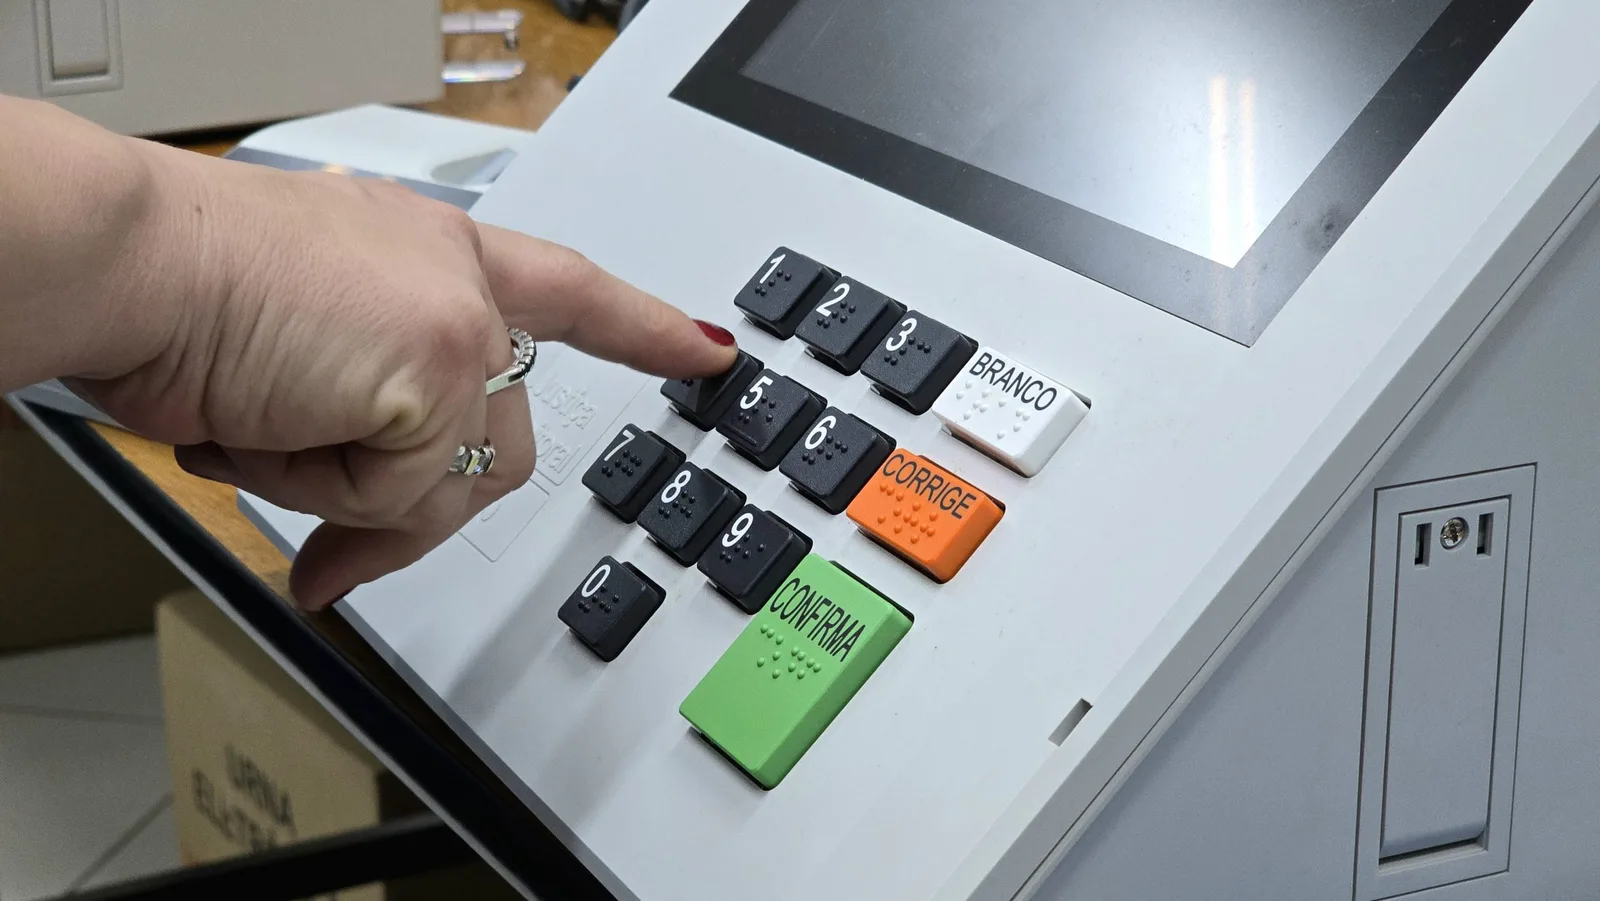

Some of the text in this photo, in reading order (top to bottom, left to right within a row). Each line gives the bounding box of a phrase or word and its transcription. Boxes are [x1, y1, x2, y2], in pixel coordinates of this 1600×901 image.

[758, 253, 786, 284] 1
[815, 282, 851, 318] 2
[885, 317, 918, 352] 3
[739, 375, 774, 410] 5
[968, 352, 1058, 411] BRANCO
[603, 429, 636, 462] 7
[804, 415, 837, 450] 6
[660, 469, 692, 504] 8
[882, 453, 977, 520] CORRIGE
[721, 512, 754, 548] 9
[581, 564, 611, 598] 0
[769, 577, 866, 663] CONFIRMA
